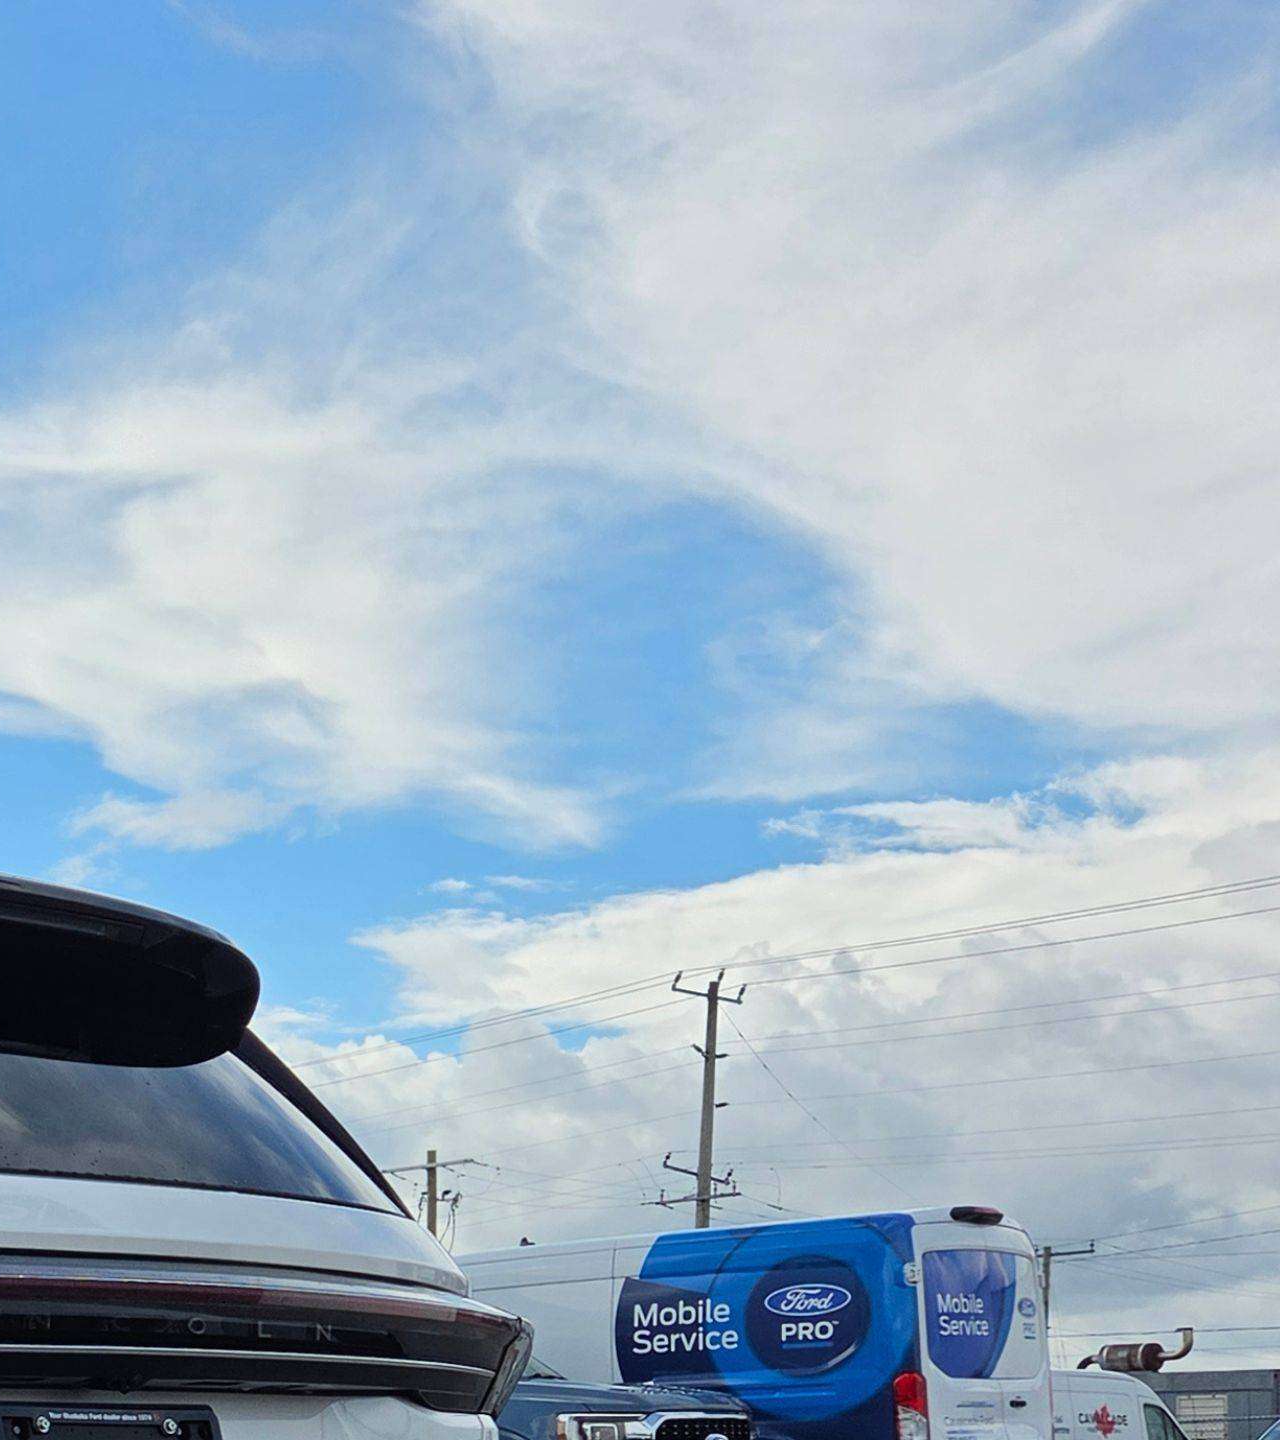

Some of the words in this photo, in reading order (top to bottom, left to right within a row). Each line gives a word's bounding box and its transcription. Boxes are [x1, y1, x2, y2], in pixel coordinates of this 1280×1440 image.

[780, 1288, 834, 1312] Ford
[936, 1292, 984, 1314] Mobile
[632, 1298, 731, 1328] Mobile
[781, 1320, 835, 1343] PRO
[939, 1315, 990, 1336] Service
[632, 1327, 739, 1354] Service
